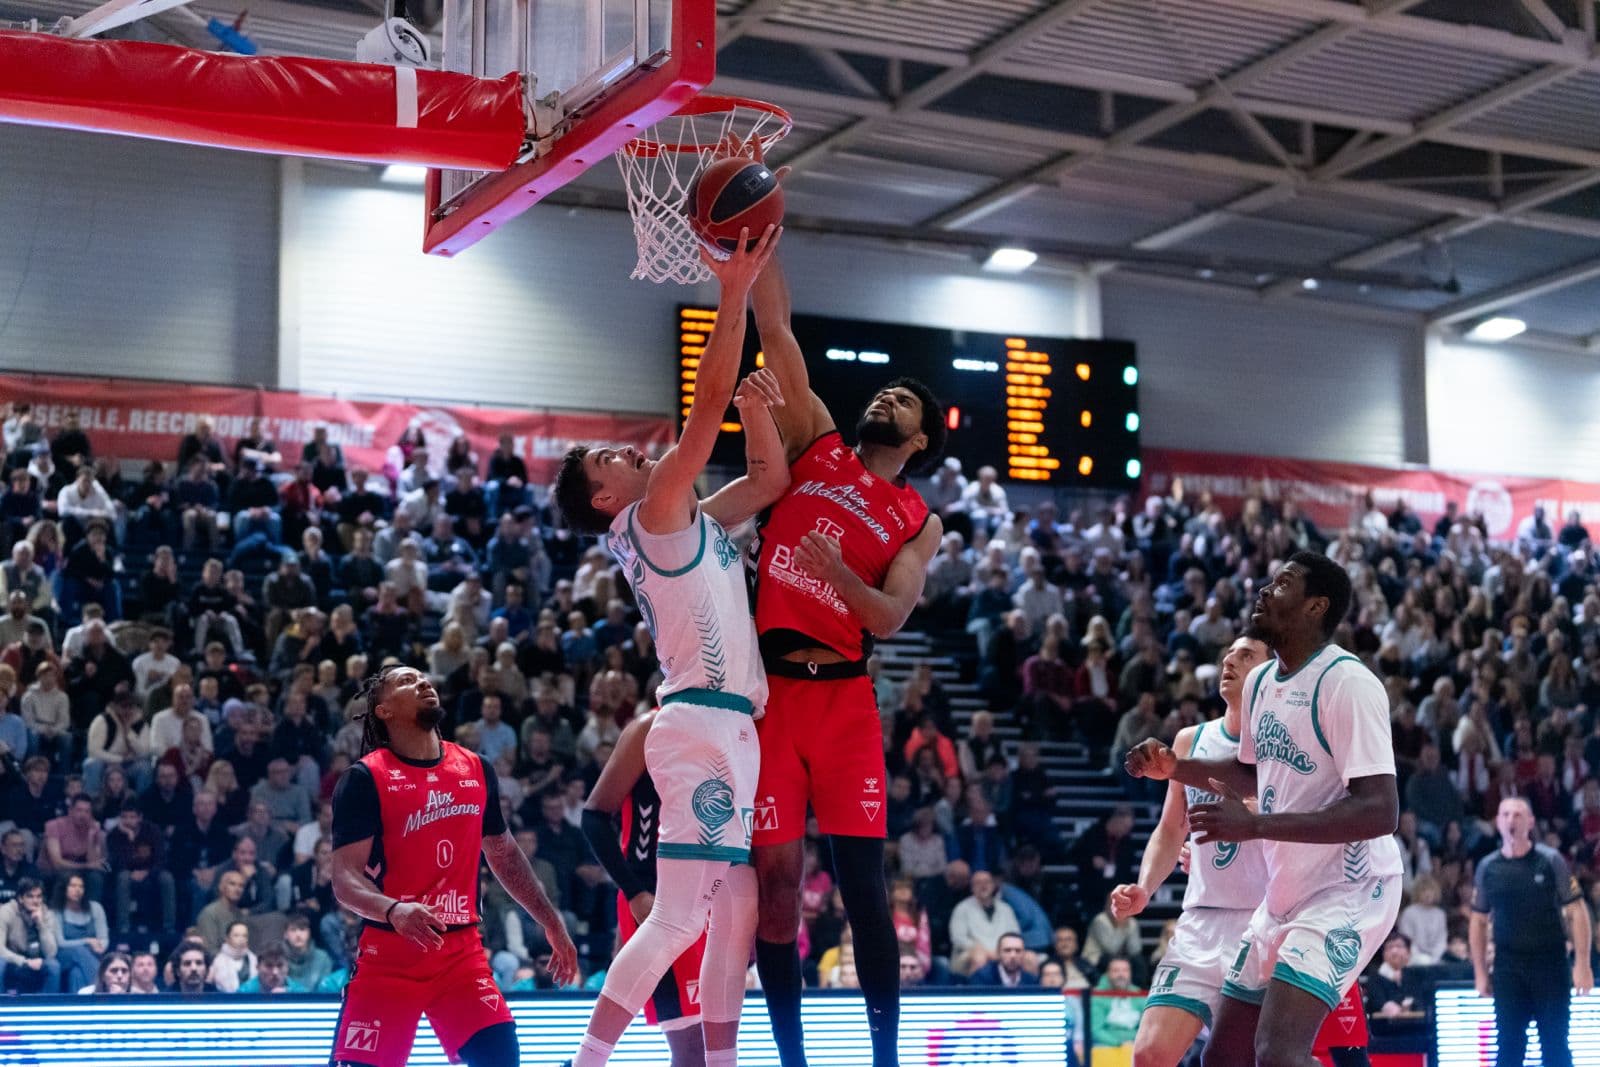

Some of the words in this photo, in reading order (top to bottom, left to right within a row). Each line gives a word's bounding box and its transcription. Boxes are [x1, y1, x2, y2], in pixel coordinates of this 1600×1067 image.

[793, 479, 891, 544] Maurienne
[831, 484, 871, 510] Aix
[426, 789, 456, 813] Aix
[403, 803, 481, 838] Maurienne
[436, 839, 454, 869] 0
[1211, 840, 1241, 871] 9
